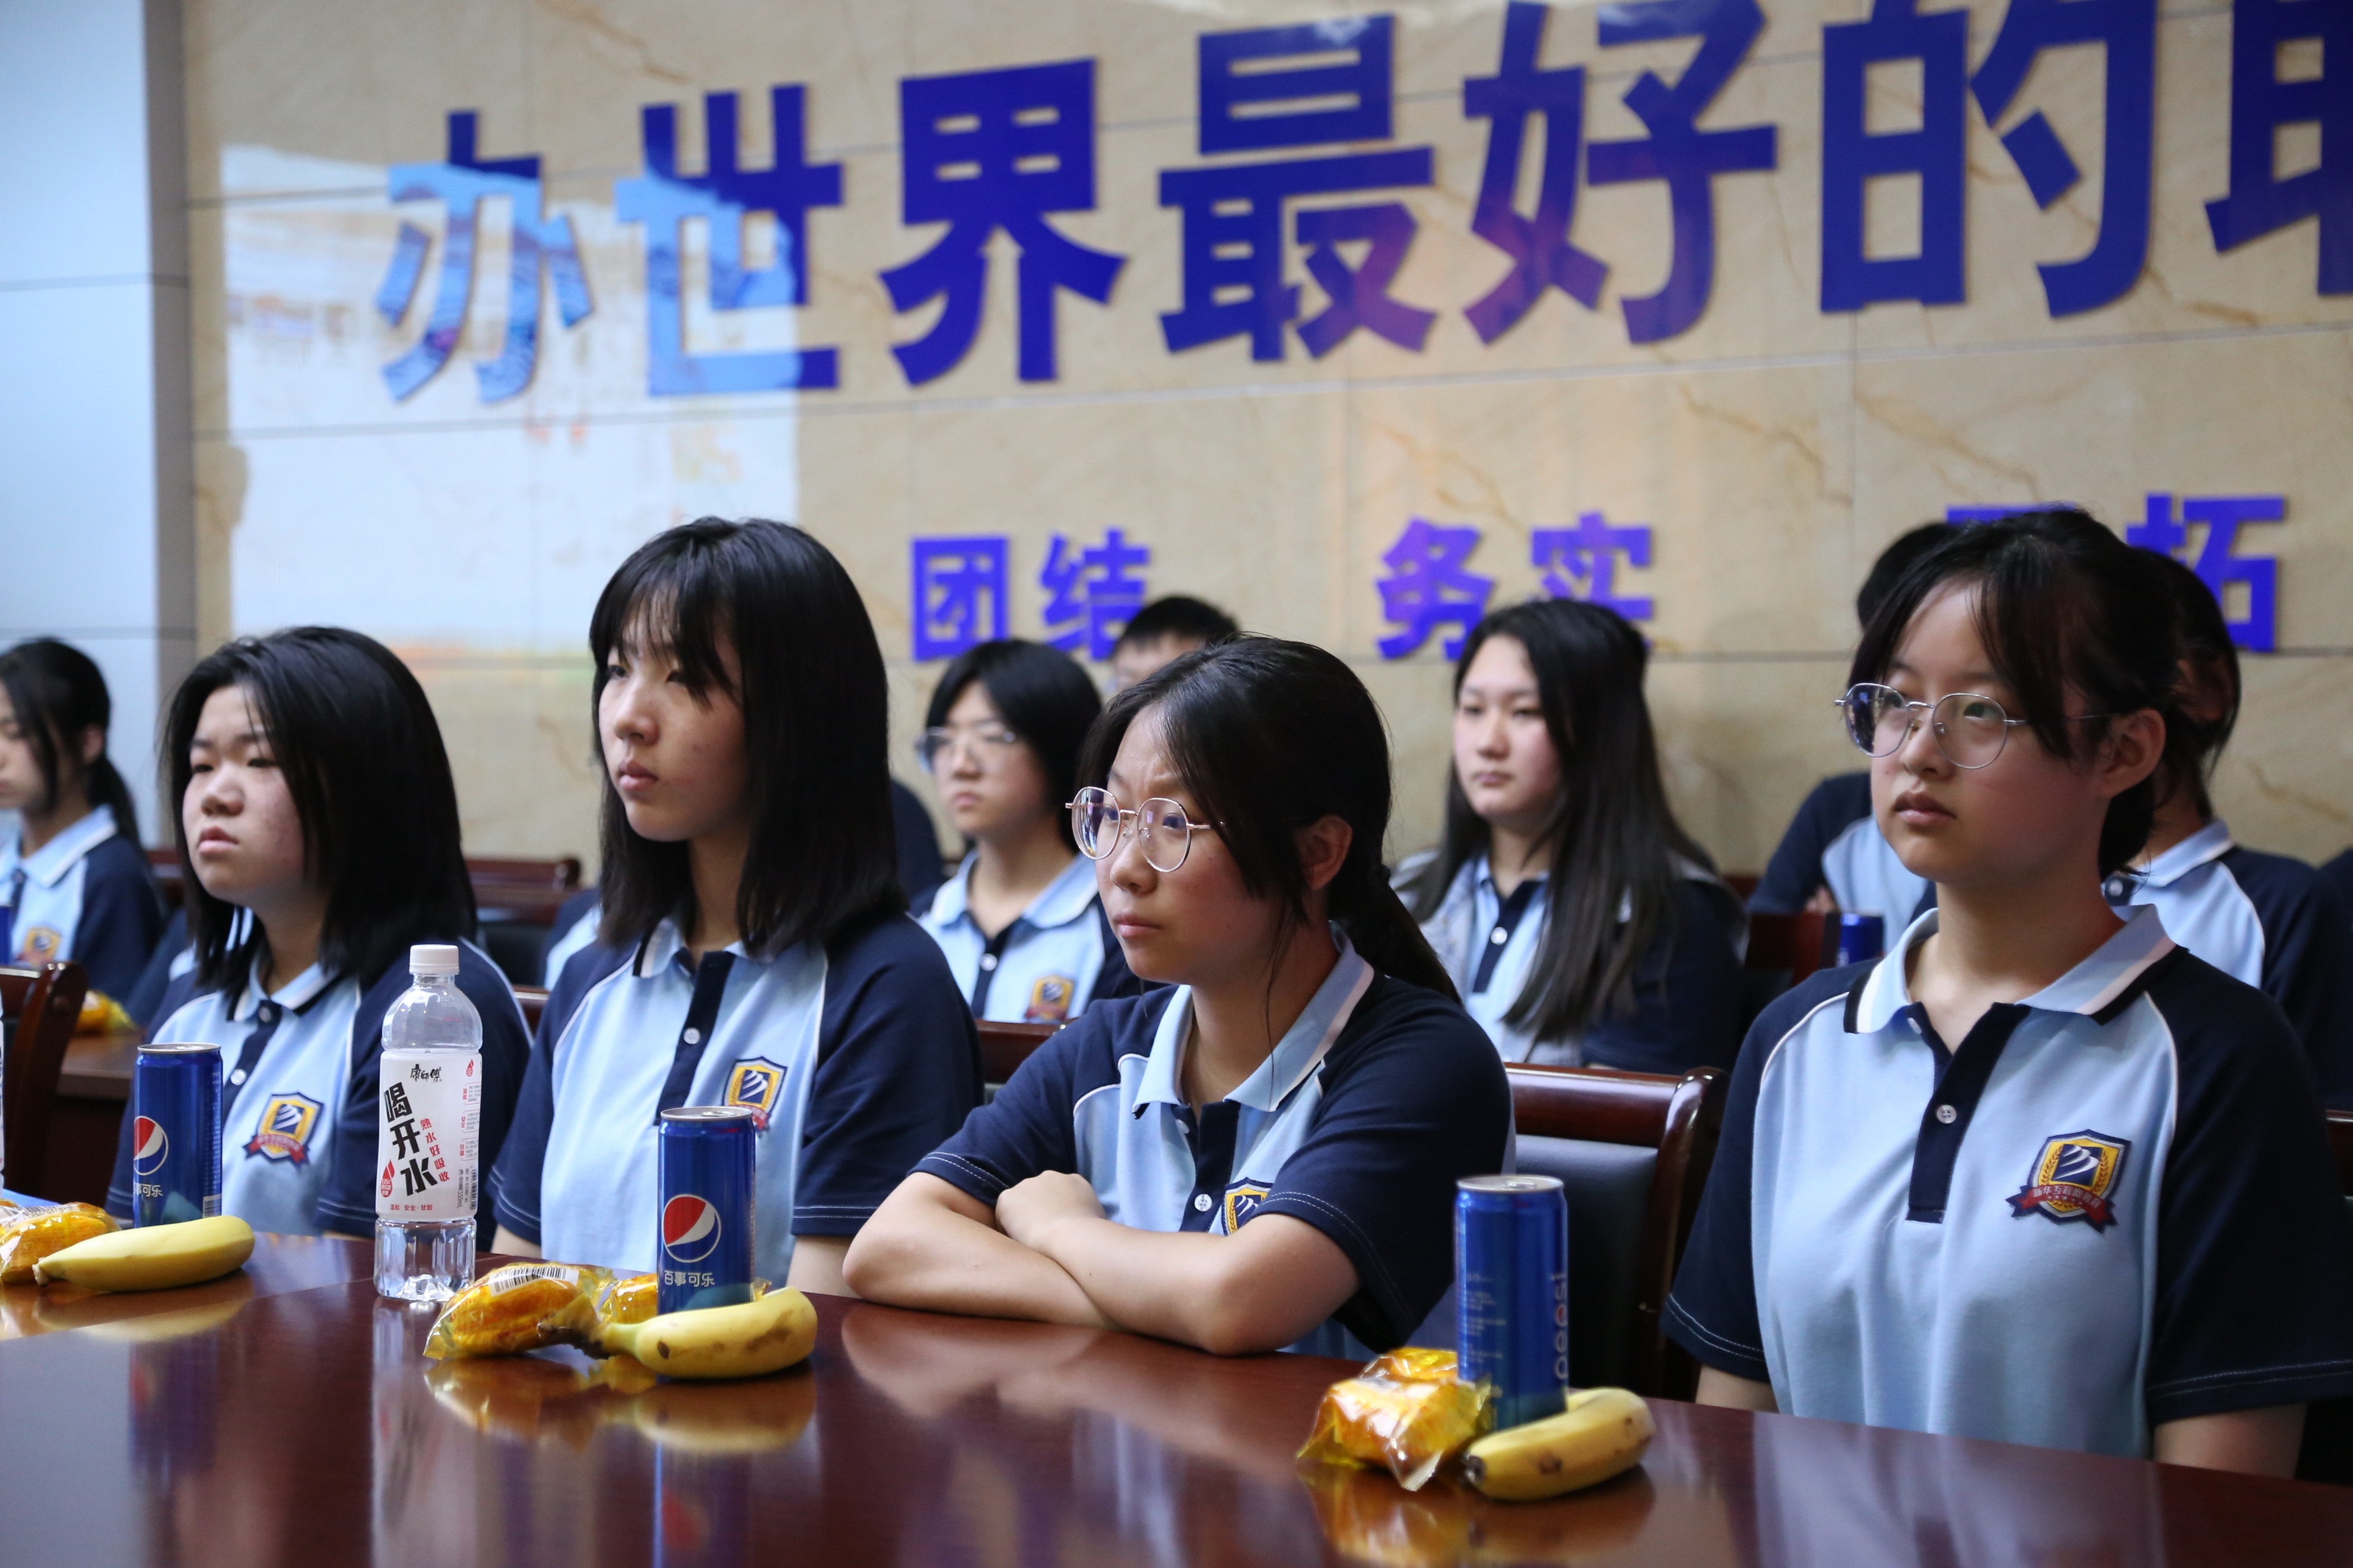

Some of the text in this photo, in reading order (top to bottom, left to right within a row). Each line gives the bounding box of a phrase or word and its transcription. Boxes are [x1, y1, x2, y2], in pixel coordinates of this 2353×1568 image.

[912, 527, 1150, 662] 团结
[1376, 510, 1655, 660] 务实
[383, 1082, 438, 1197] 喝开水
[664, 1271, 715, 1287] 百事可乐
